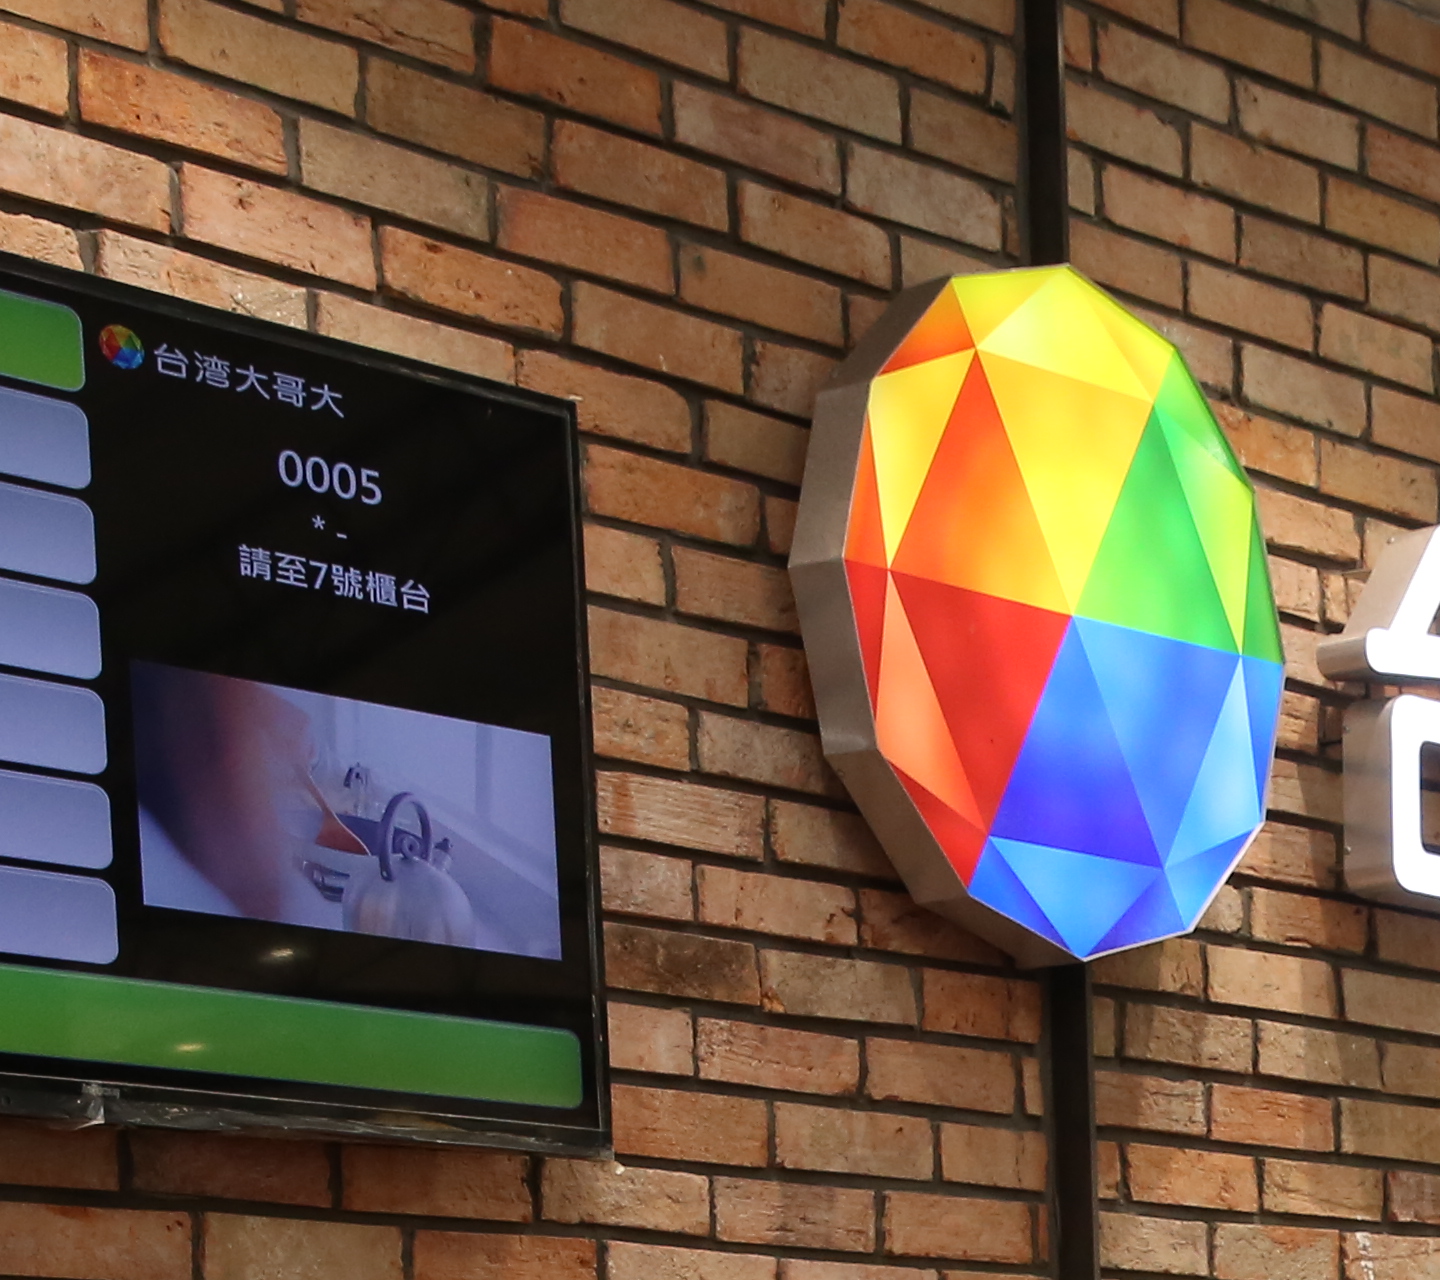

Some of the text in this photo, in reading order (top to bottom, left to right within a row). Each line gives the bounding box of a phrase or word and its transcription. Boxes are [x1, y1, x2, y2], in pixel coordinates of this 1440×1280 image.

[277, 449, 384, 507] 0005
[238, 542, 432, 613] 請至7號櫃台
